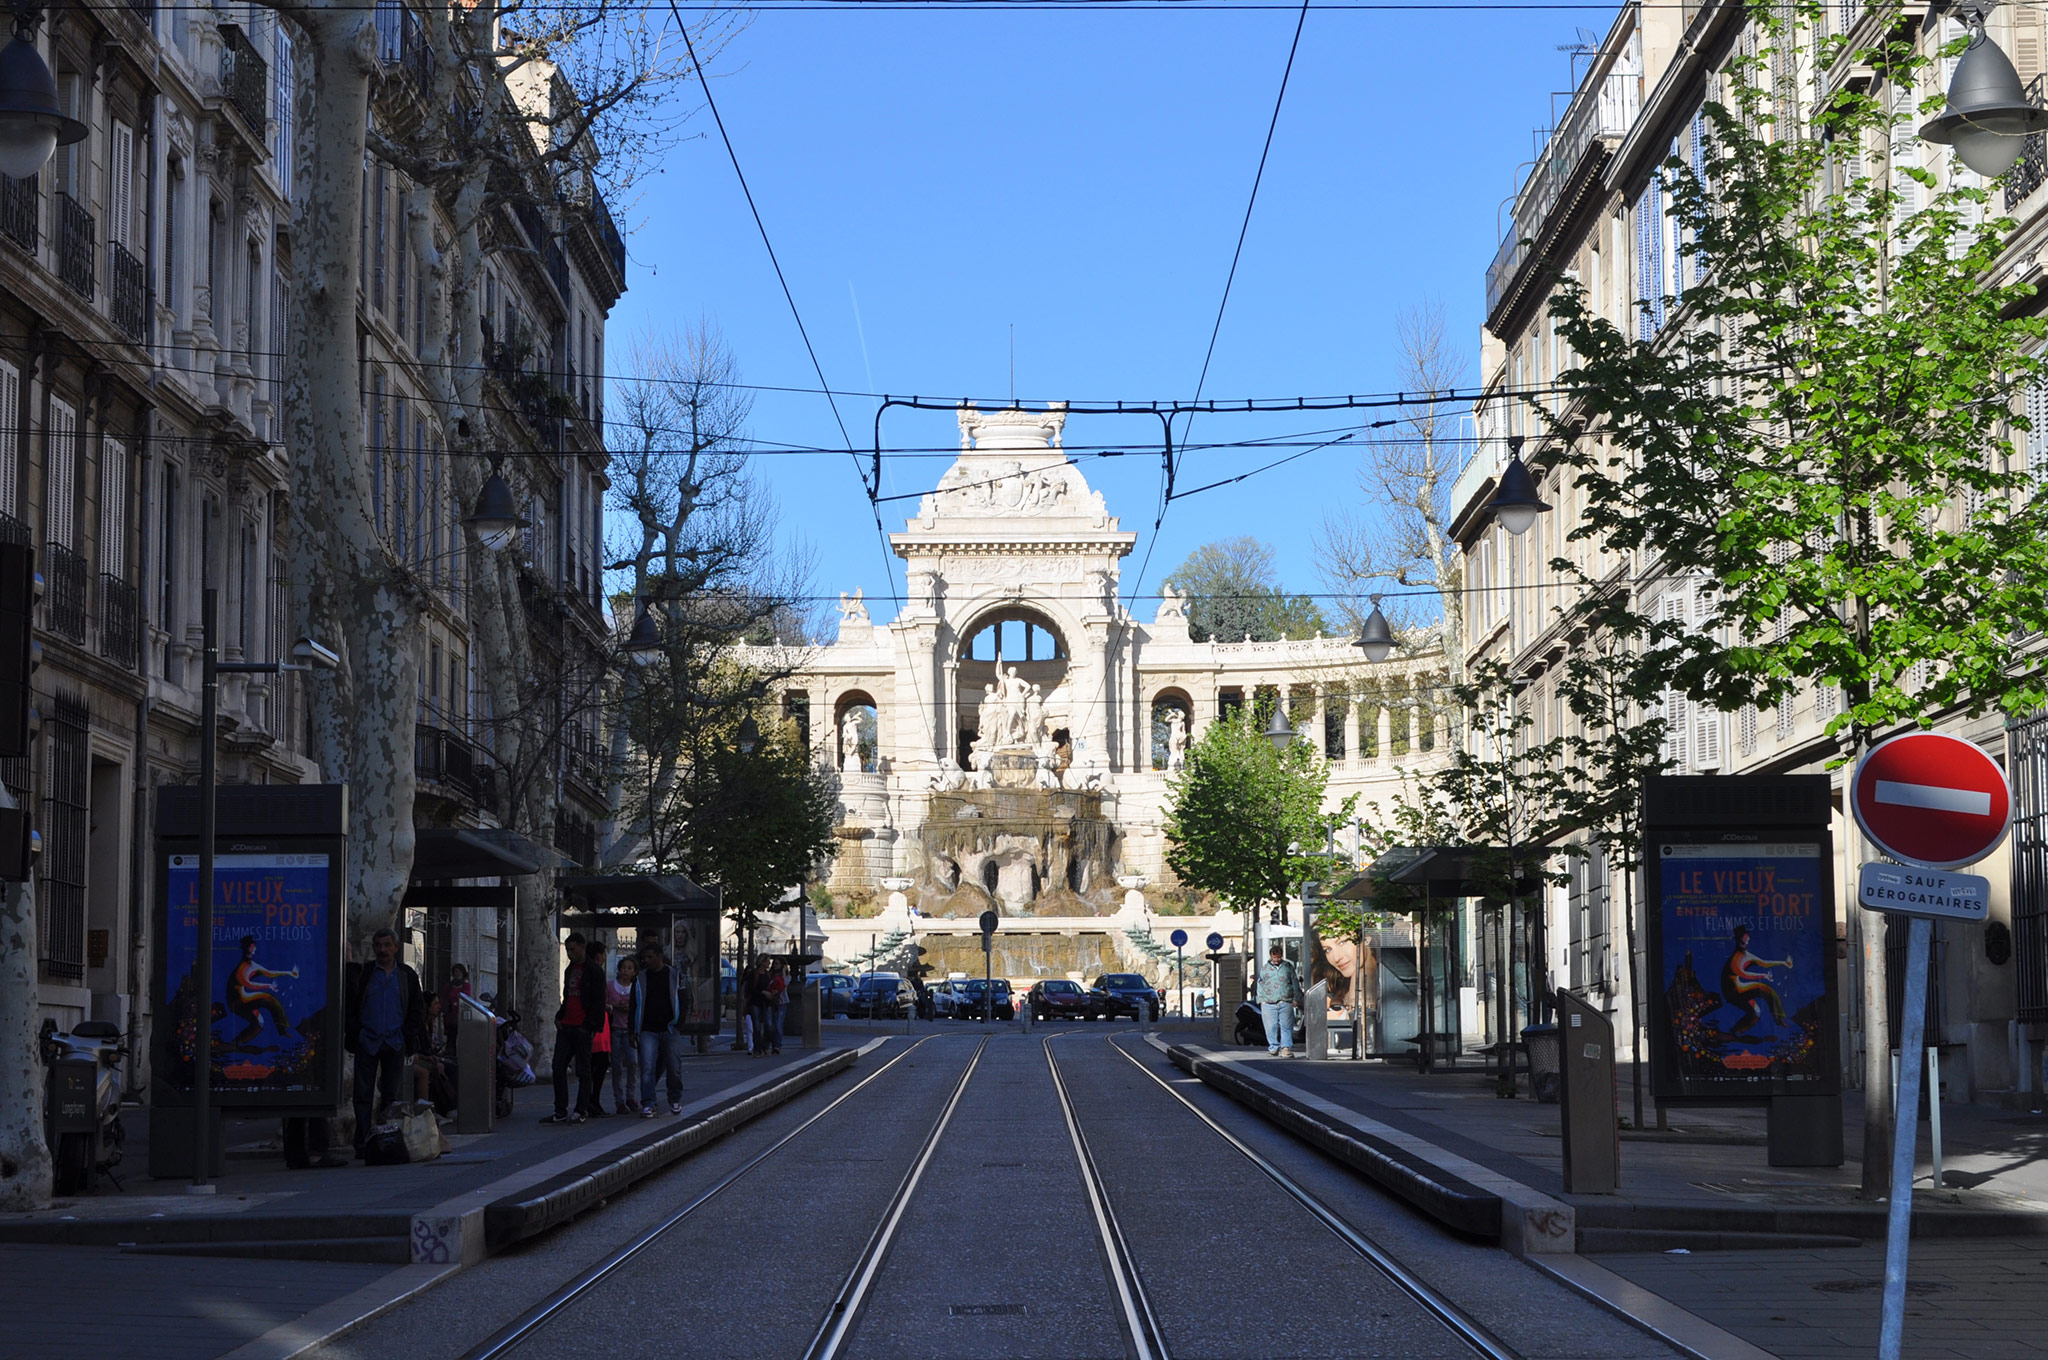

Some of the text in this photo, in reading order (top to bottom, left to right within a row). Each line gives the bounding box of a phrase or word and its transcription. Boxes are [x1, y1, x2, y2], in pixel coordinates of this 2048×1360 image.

[1721, 833, 1760, 841] JCDecaux
[230, 843, 267, 851] JCDecaux
[1680, 871, 1776, 894] LE VIEUX
[1904, 875, 1946, 888] SAUF
[222, 881, 284, 904] VIEUX
[1866, 886, 1981, 911] DÉROGATAIRES
[1676, 906, 1719, 917] ENTRE
[1757, 893, 1814, 917] PORT
[265, 904, 322, 926] PORT
[1705, 916, 1805, 931] FLAMMES ET FLOTS
[213, 926, 312, 942] FLAMMES ET FLOTS
